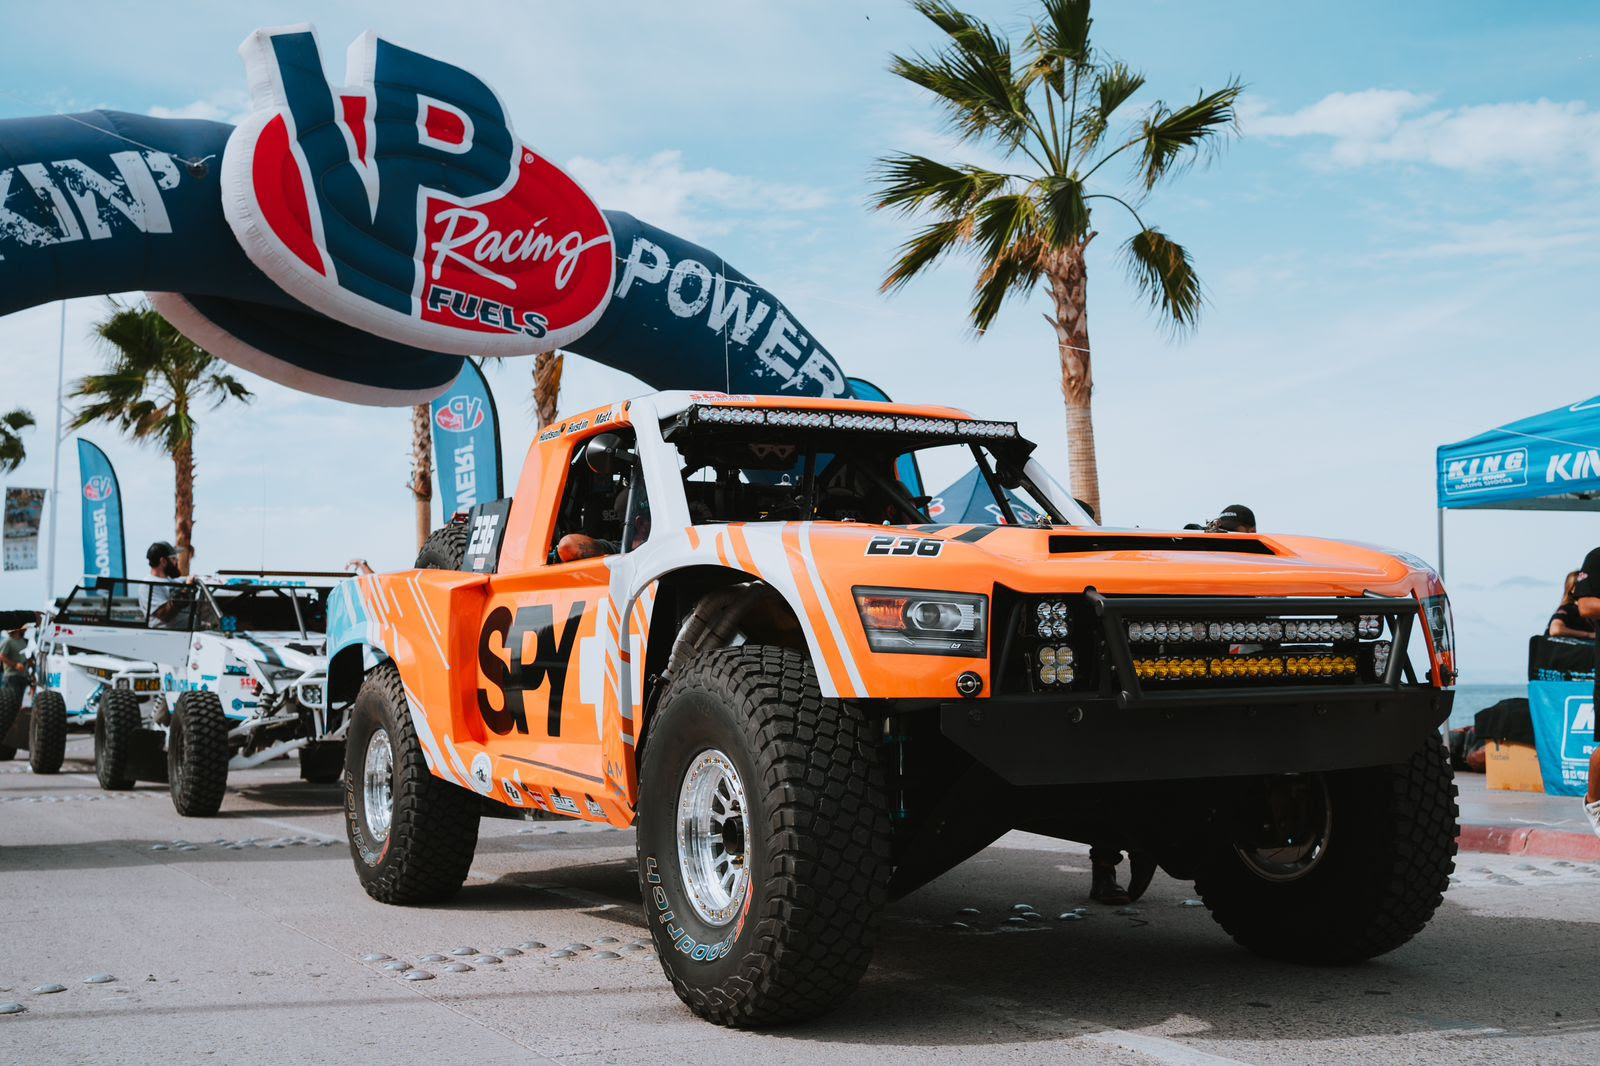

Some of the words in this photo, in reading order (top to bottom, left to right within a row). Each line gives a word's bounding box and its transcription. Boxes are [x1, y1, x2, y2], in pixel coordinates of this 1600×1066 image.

[268, 31, 514, 316] VP
[431, 208, 611, 290] Racing
[427, 284, 548, 338] FUELS
[614, 235, 854, 399] POWER
[595, 412, 612, 424] Matt
[1448, 452, 1524, 479] KING
[468, 514, 499, 555] 236
[866, 535, 945, 557] 236
